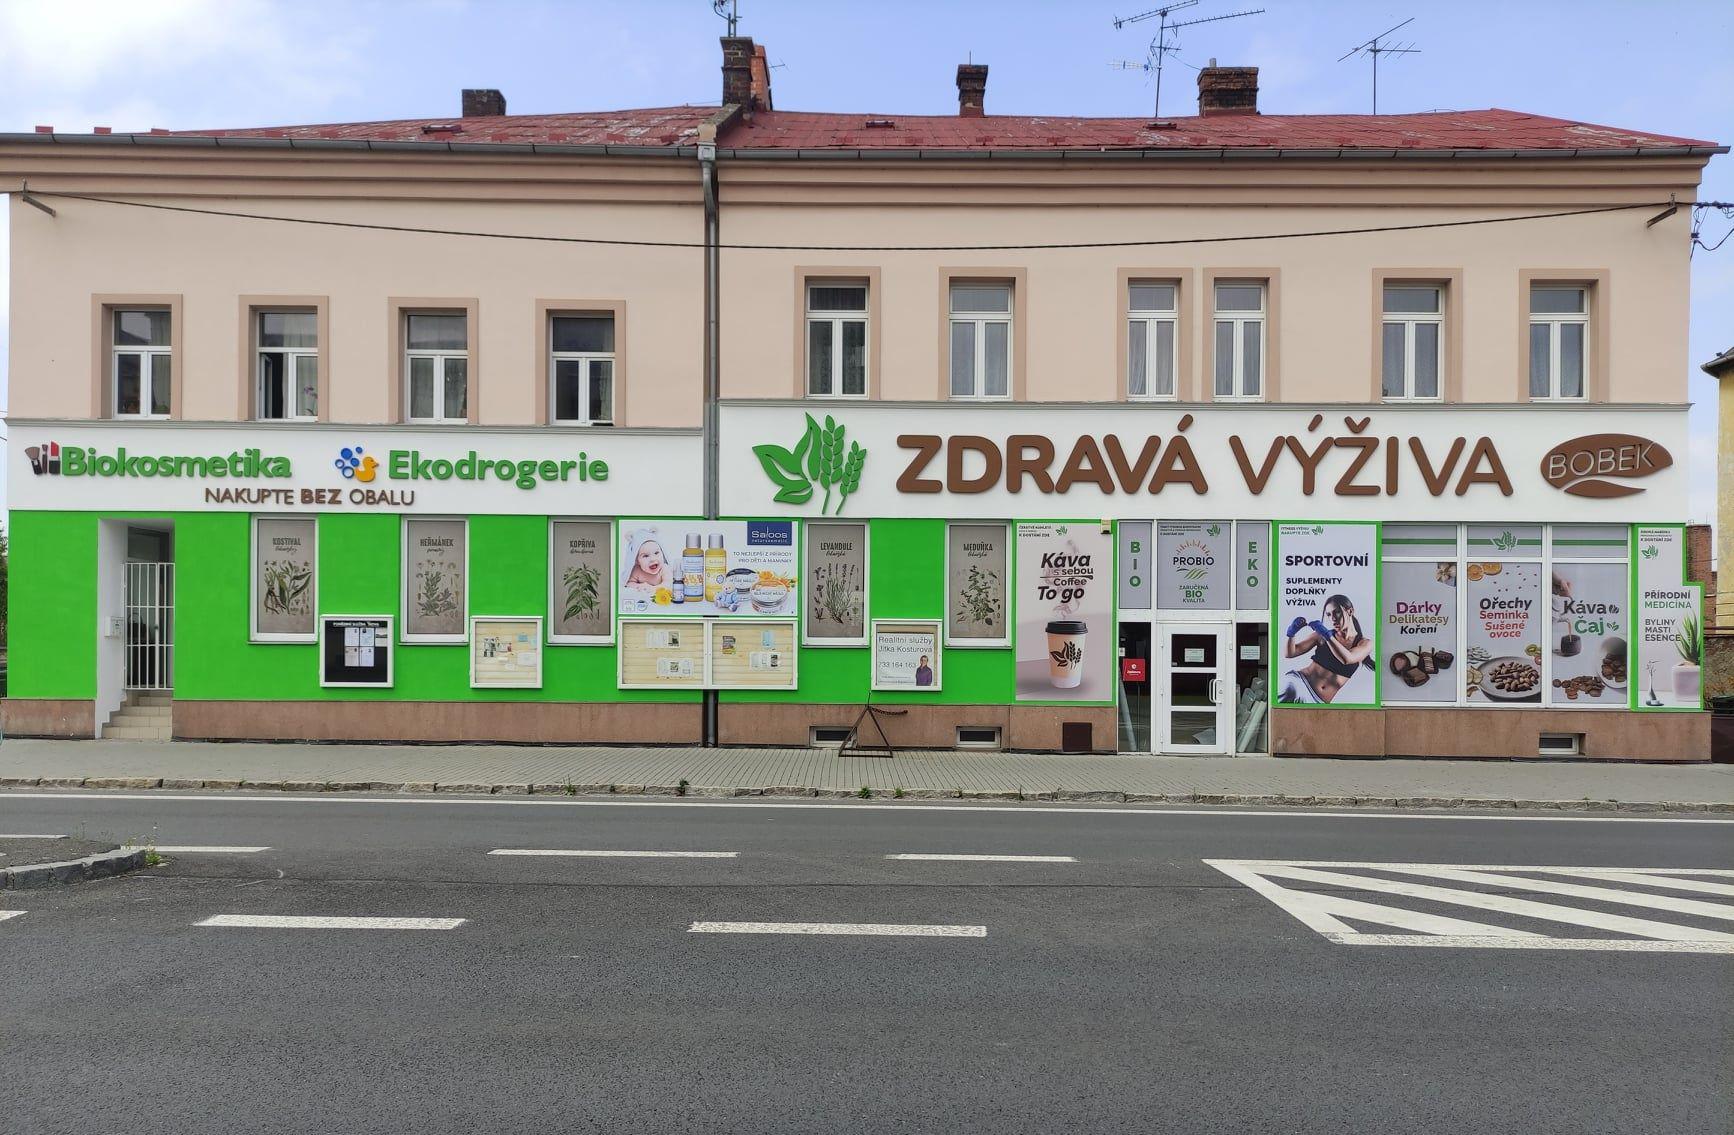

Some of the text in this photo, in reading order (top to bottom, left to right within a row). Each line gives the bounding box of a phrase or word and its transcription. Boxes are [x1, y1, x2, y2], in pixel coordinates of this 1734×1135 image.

[896, 414, 1514, 497] ZDRAVÁ VÝŽIVA
[1548, 442, 1655, 479] BOBEK
[61, 446, 292, 478] Biokosmetika
[389, 450, 609, 489] Ekodrogerie
[205, 487, 415, 506] NAKUPTE BEZ OBALU
[751, 526, 788, 539] Saloos
[420, 536, 454, 547] HEŘMÁNEK
[569, 538, 596, 548] KOPŘIVA
[820, 542, 853, 551] LEVANDULE
[963, 541, 993, 551] MEDUŇKA
[1040, 552, 1091, 569] Káva
[1172, 556, 1215, 566] PROBIO
[1285, 553, 1369, 567] SPORTOVNÍ
[1061, 567, 1094, 575] sebou
[1053, 577, 1088, 586] Coffee
[1286, 577, 1343, 585] SUPLEMENTY
[1037, 585, 1085, 604] To go
[1185, 590, 1203, 598] BIO
[1285, 587, 1327, 595] DOPLŇKY
[1644, 590, 1691, 599] PŘÍRODNÍ
[1286, 598, 1317, 606] VÝŽIVA
[1479, 597, 1533, 610] Ořechy
[1563, 600, 1607, 615] Káva
[1396, 601, 1443, 615] Dárky
[1389, 614, 1449, 626] Delikatesy
[1485, 620, 1525, 631] Sušené
[1645, 618, 1676, 626] BYLINY
[1400, 624, 1438, 635] Koření
[1574, 616, 1605, 636] Čaj
[1489, 630, 1521, 638] ovoce
[879, 645, 895, 653] Jitka
